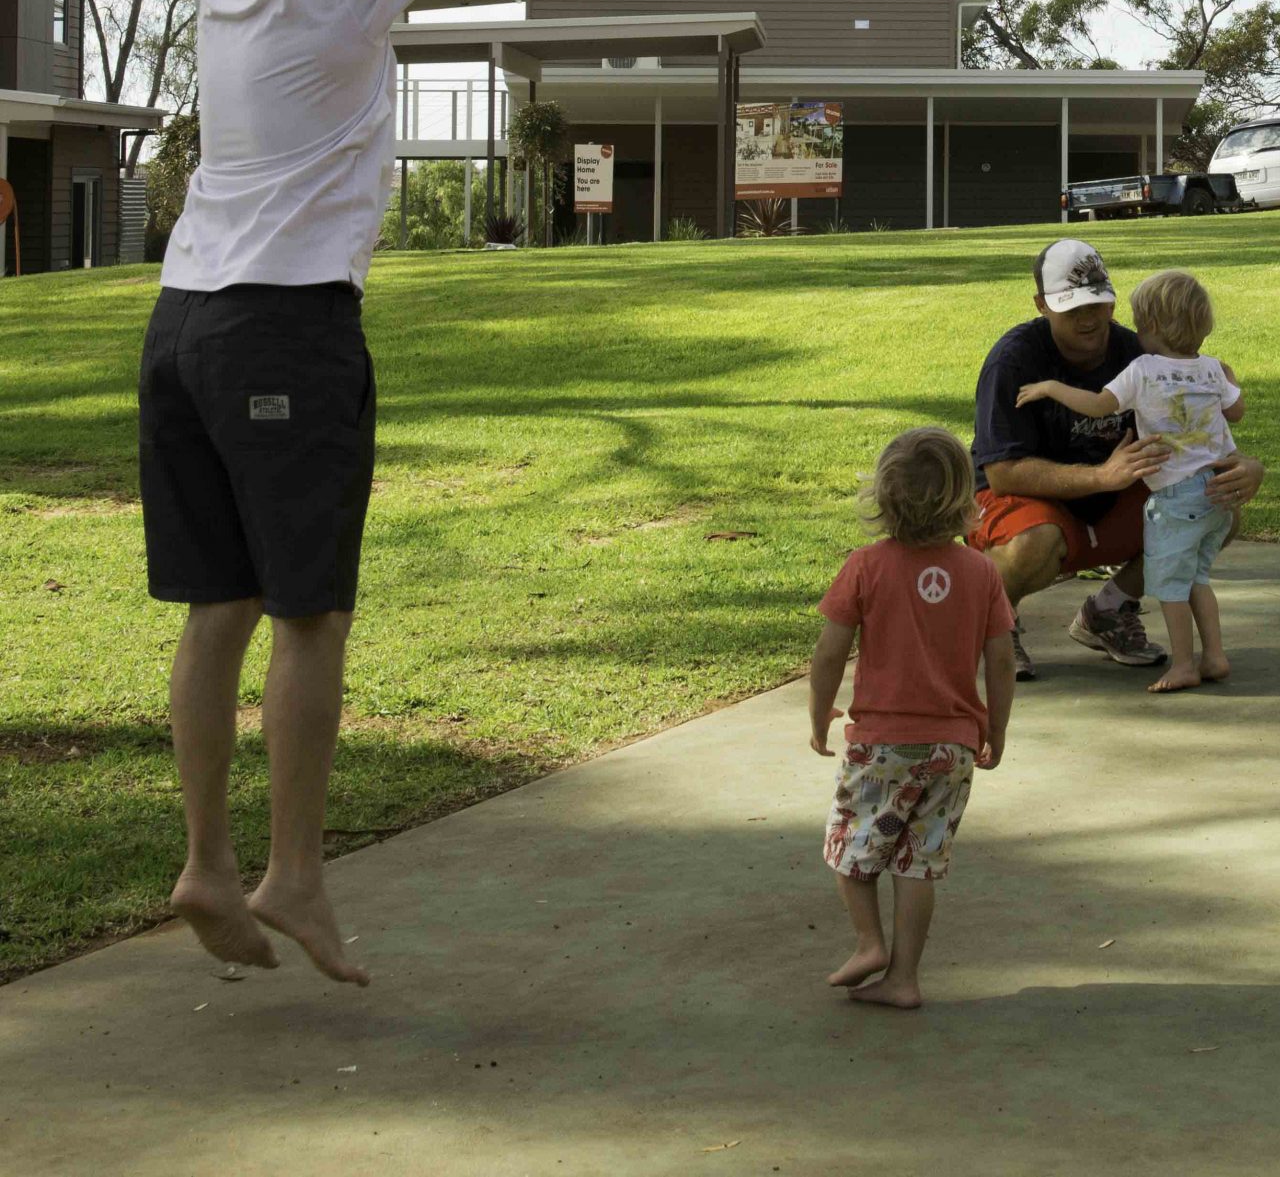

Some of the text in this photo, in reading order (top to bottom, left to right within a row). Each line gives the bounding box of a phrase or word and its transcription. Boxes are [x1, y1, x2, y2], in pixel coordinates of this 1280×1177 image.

[576, 157, 600, 166] Display
[825, 161, 837, 169] Sale
[576, 166, 595, 174] Home
[576, 177, 588, 185] You
